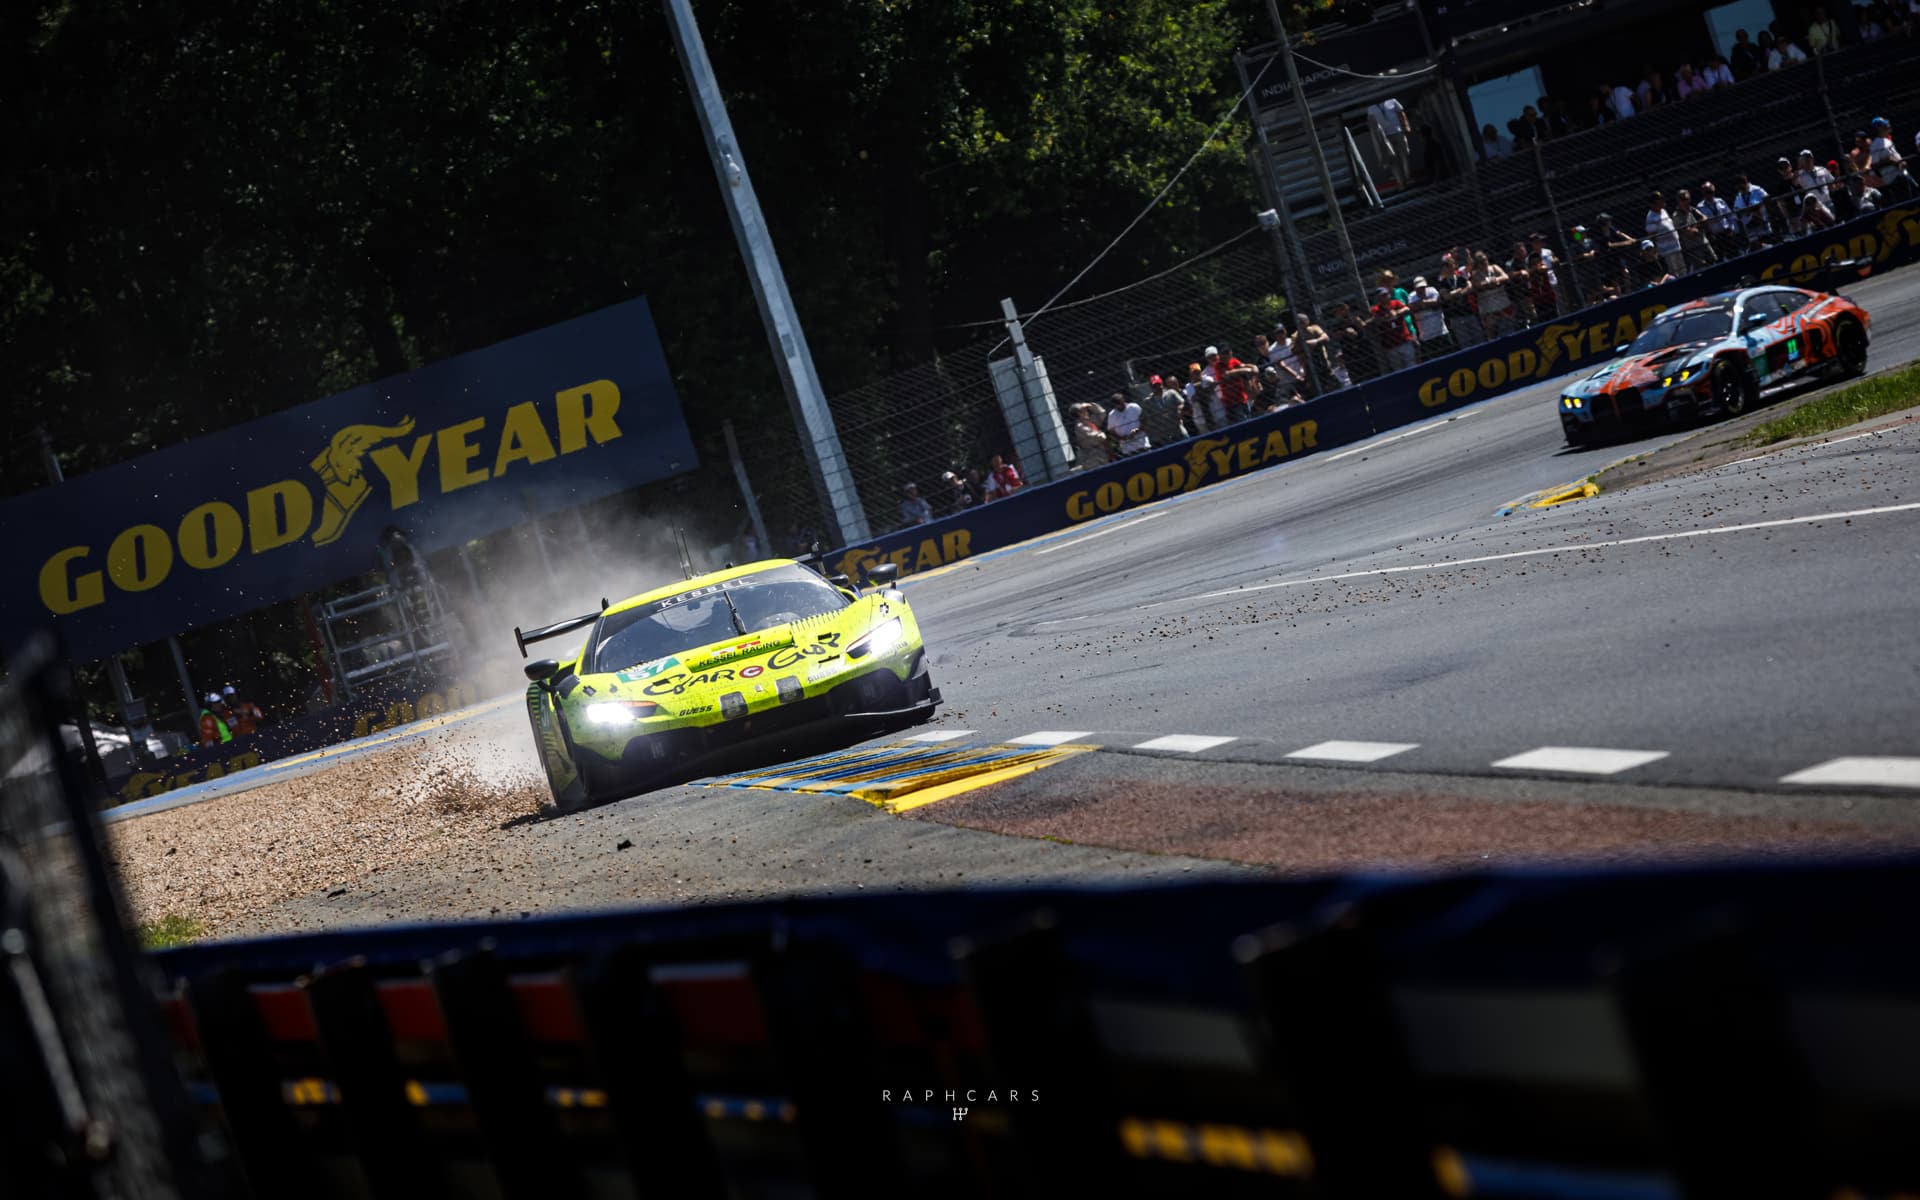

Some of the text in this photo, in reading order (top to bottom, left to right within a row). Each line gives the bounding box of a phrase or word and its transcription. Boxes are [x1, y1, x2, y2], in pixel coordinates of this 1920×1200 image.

[1066, 420, 1318, 521] GOODYEAR
[38, 379, 622, 615] GOODYEAR
[662, 579, 750, 608] KESSEL
[698, 639, 782, 667] KESSEL RACING
[627, 658, 670, 680] 57
[679, 704, 713, 717] GUESS
